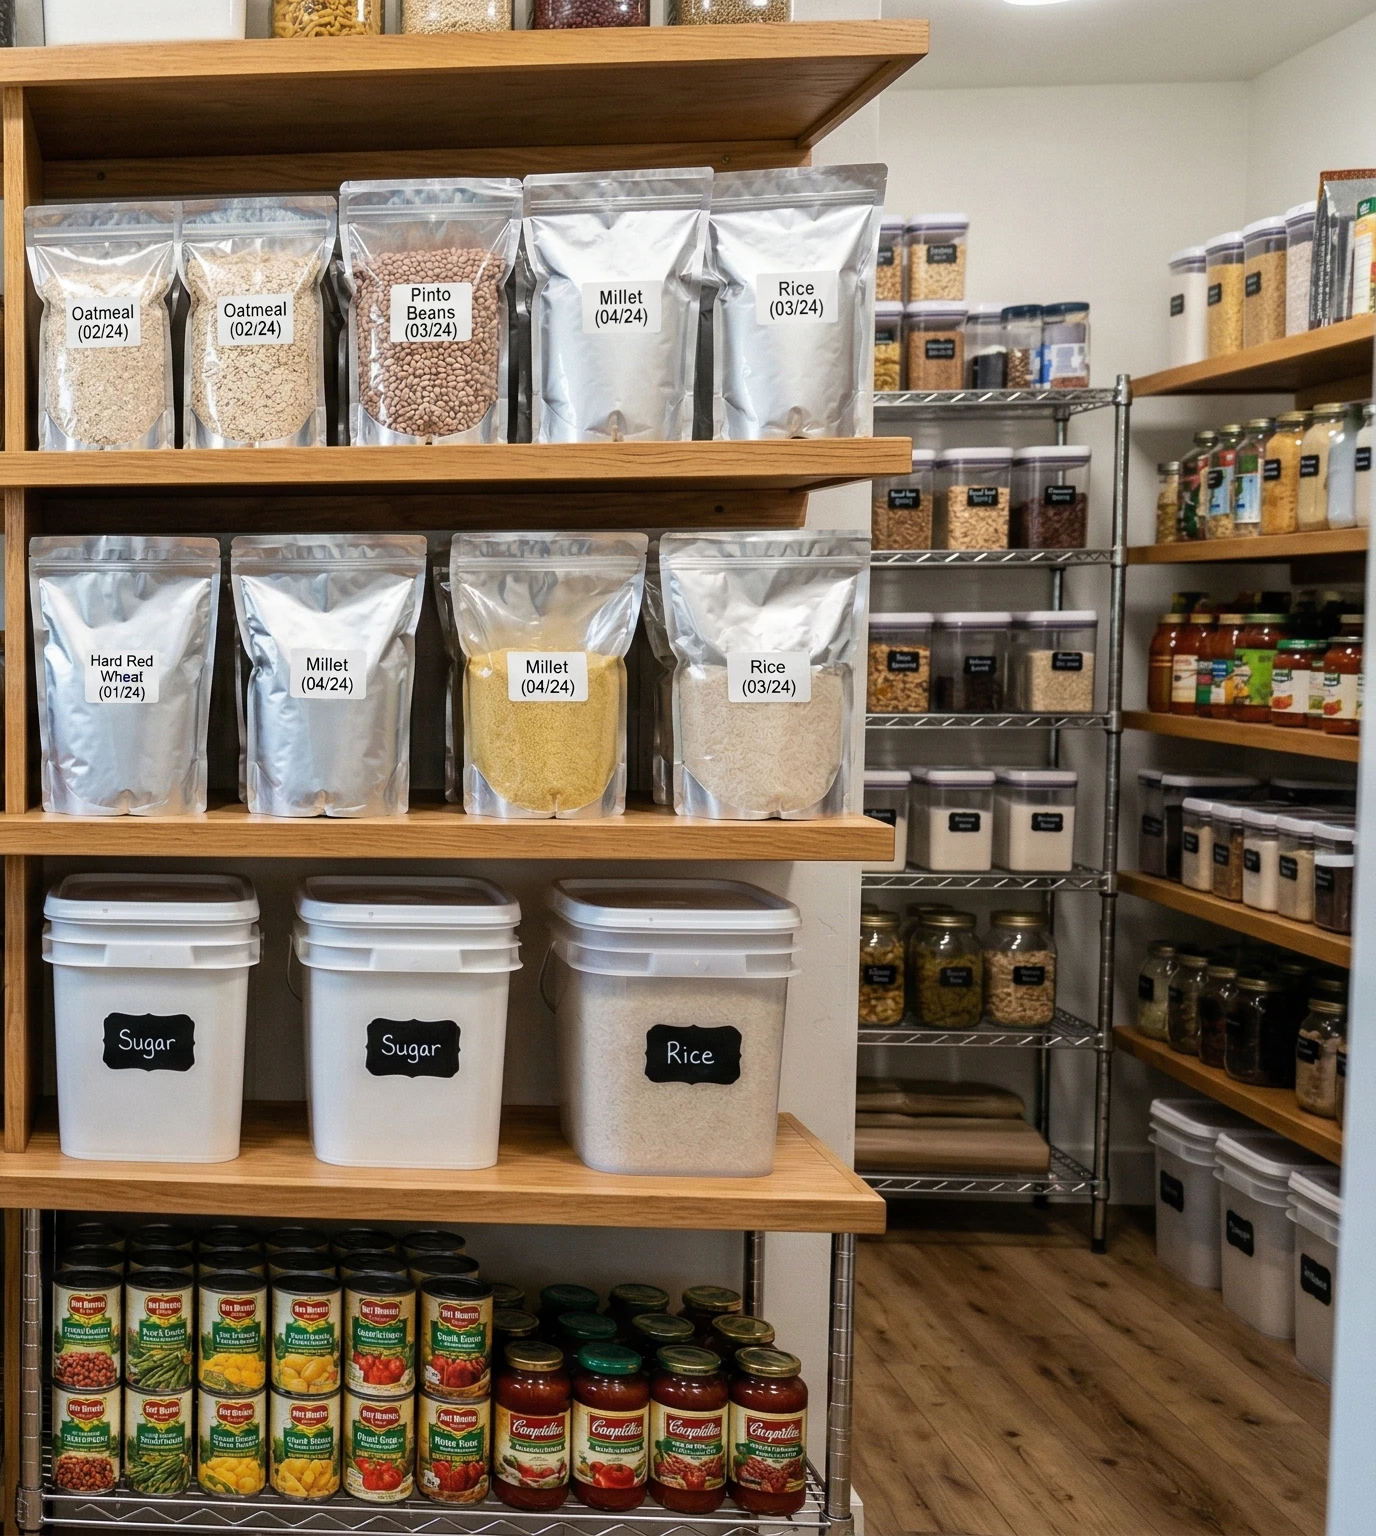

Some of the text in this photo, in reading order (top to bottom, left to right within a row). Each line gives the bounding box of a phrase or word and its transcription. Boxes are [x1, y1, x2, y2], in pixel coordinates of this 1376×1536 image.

[411, 287, 452, 303] Pinto
[599, 289, 644, 305] Millet
[778, 281, 815, 297] Rice
[71, 304, 135, 321] Oatmeal
[224, 301, 288, 318] Oatmeal
[407, 306, 456, 321] Beans
[594, 307, 649, 327] (04/24)
[769, 299, 824, 319] (03/24)
[77, 323, 130, 341] (02/24)
[230, 320, 282, 338] (02/24)
[405, 321, 458, 340] (03/24)
[90, 654, 154, 667] Hard Red
[306, 657, 349, 672] Millet
[525, 659, 569, 674] Millet
[750, 659, 786, 674] Rice
[100, 670, 144, 683] Wheat
[98, 686, 146, 701] (01/24)
[301, 676, 355, 695] (04/24)
[520, 678, 576, 697] (04/24)
[741, 678, 797, 698] (03/24)
[118, 1029, 176, 1060] Sugar
[381, 1033, 441, 1065] Sugar
[666, 1040, 715, 1065] Rice
